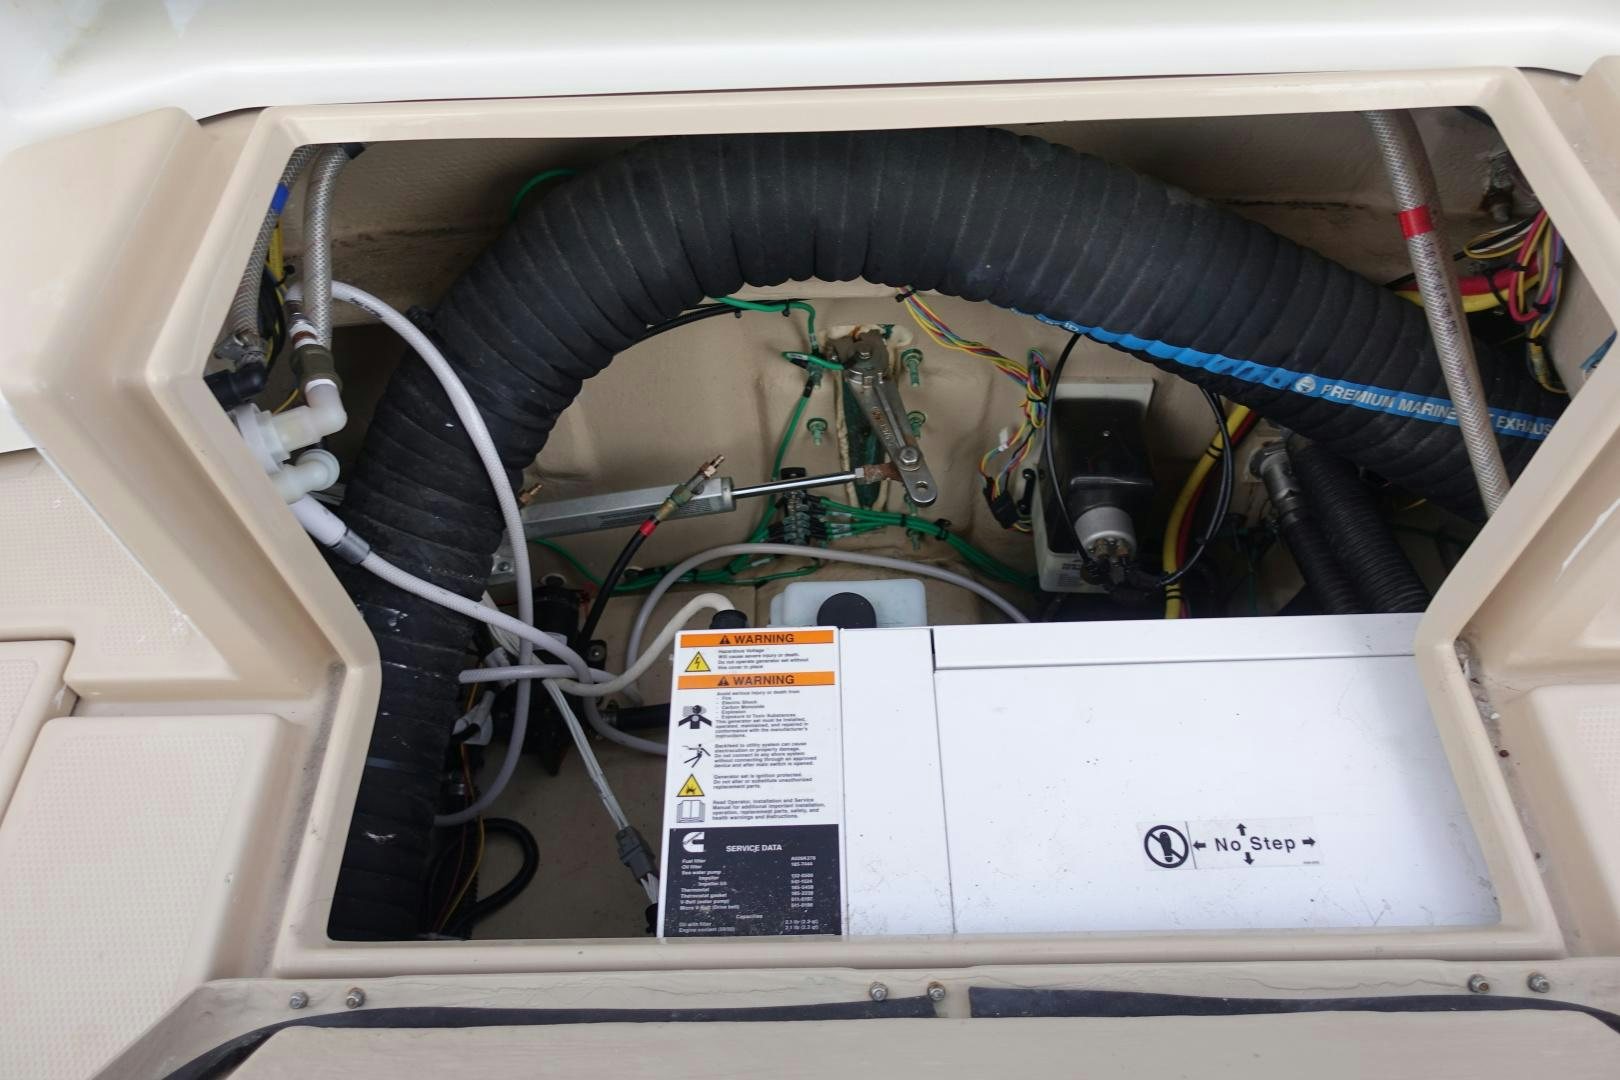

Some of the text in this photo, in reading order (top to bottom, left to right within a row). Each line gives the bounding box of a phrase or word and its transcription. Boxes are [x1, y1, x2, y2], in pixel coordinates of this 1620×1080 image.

[1320, 384, 1394, 408] PREMIUM
[1400, 399, 1456, 420] MARINE
[734, 634, 795, 644] WARNING
[733, 675, 795, 686] WARNING
[1214, 836, 1296, 853] No Step
